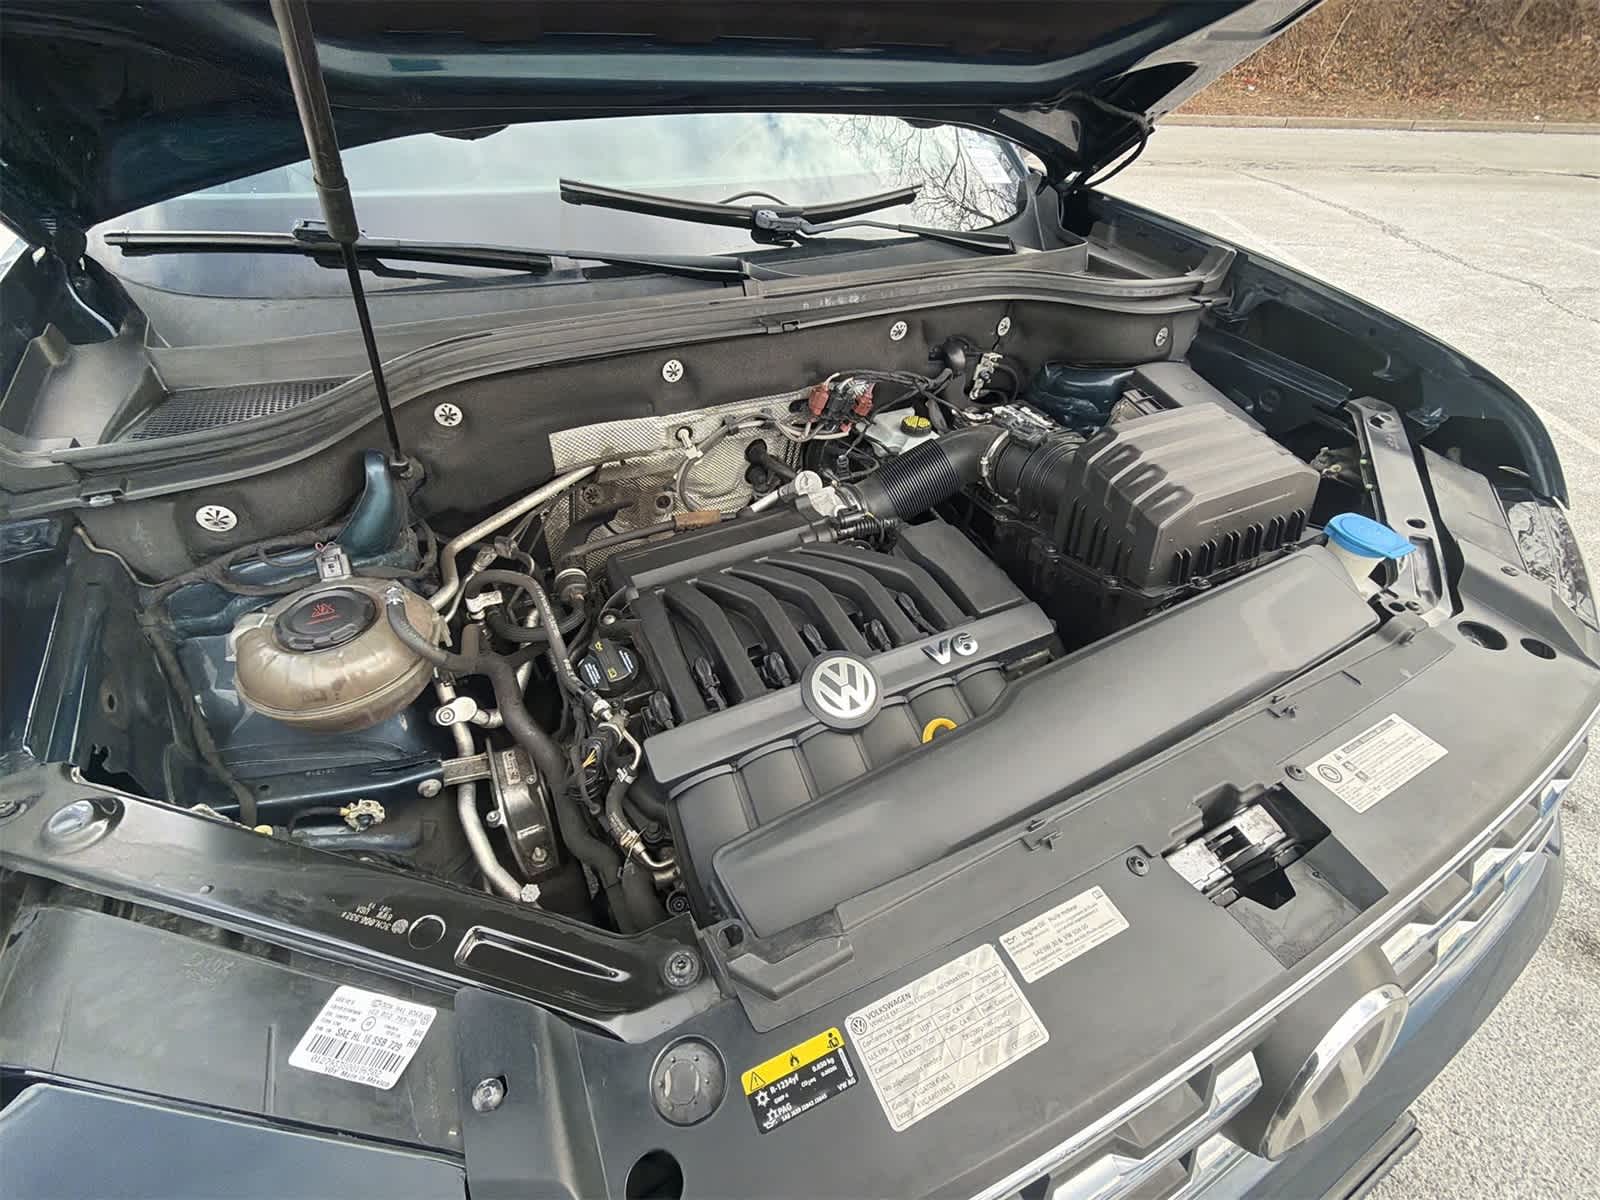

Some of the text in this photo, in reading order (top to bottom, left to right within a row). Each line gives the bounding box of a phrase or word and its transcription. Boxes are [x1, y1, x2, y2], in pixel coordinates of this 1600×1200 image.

[920, 632, 979, 665] V6
[865, 993, 911, 1020] VOLKSWAGEN
[869, 1013, 890, 1028] VEHICLE
[937, 971, 970, 990] INFORMATION
[335, 1027, 352, 1039] SAE
[350, 1031, 361, 1042] HL
[770, 1073, 799, 1094] R-1234yf
[837, 1077, 856, 1091] VW AG
[777, 1103, 792, 1115] PAG
